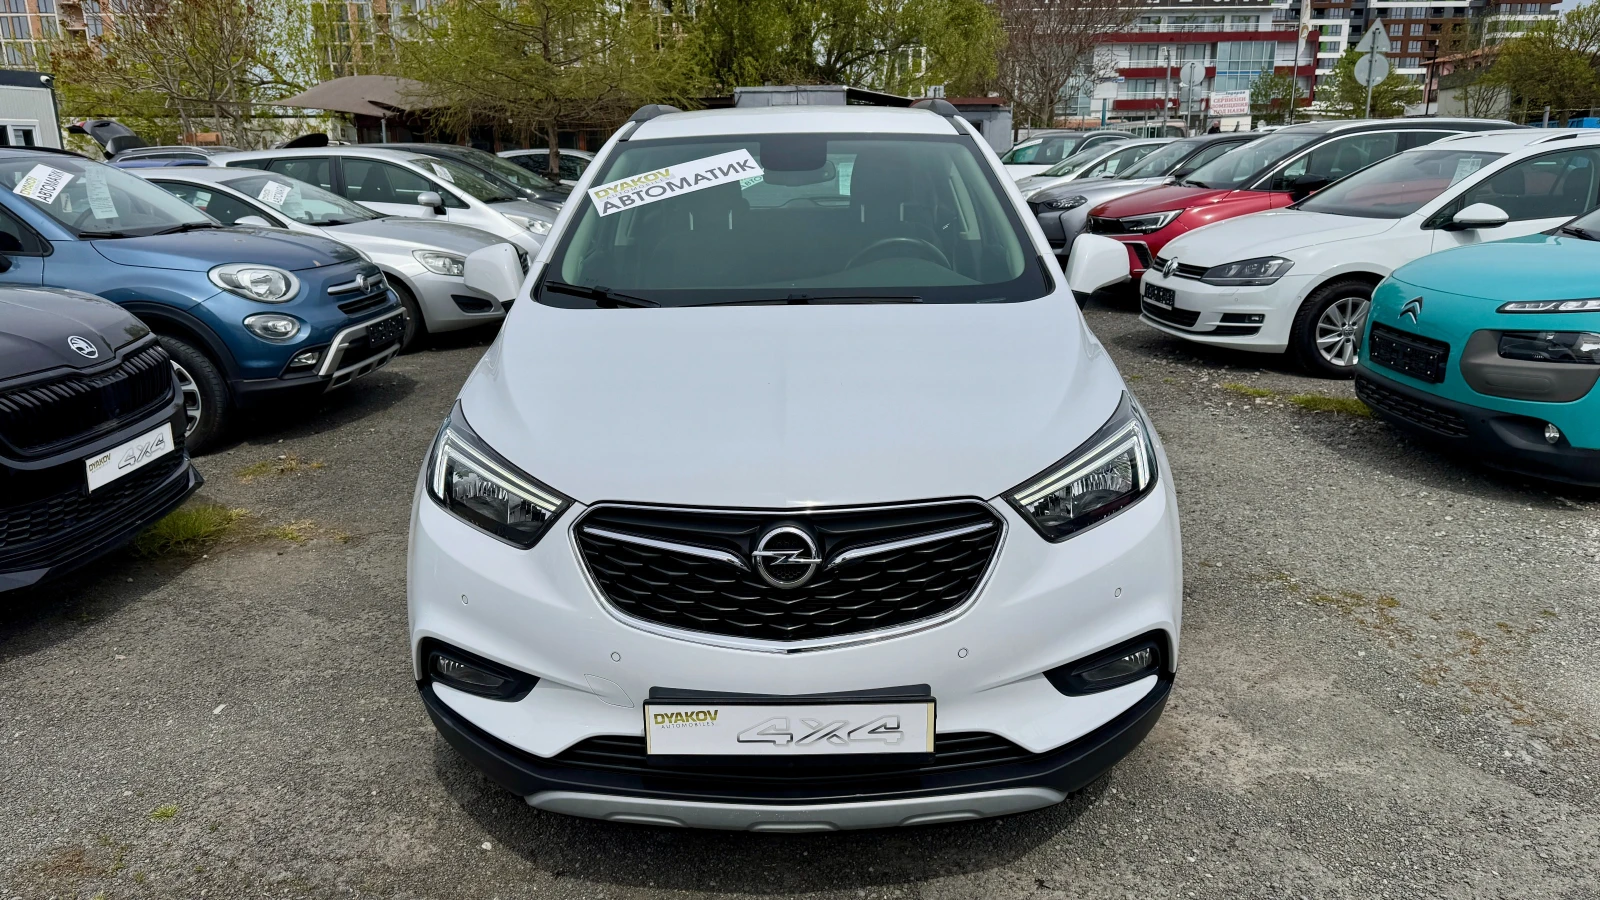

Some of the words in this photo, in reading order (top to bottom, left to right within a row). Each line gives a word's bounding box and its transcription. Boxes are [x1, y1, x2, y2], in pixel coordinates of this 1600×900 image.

[594, 168, 670, 199] DYAKOV
[602, 158, 756, 215] АВТОМАТИК
[88, 452, 111, 472] DYAKOV
[653, 709, 718, 725] DYAKOV
[661, 721, 715, 730] AUTOMOBILES
